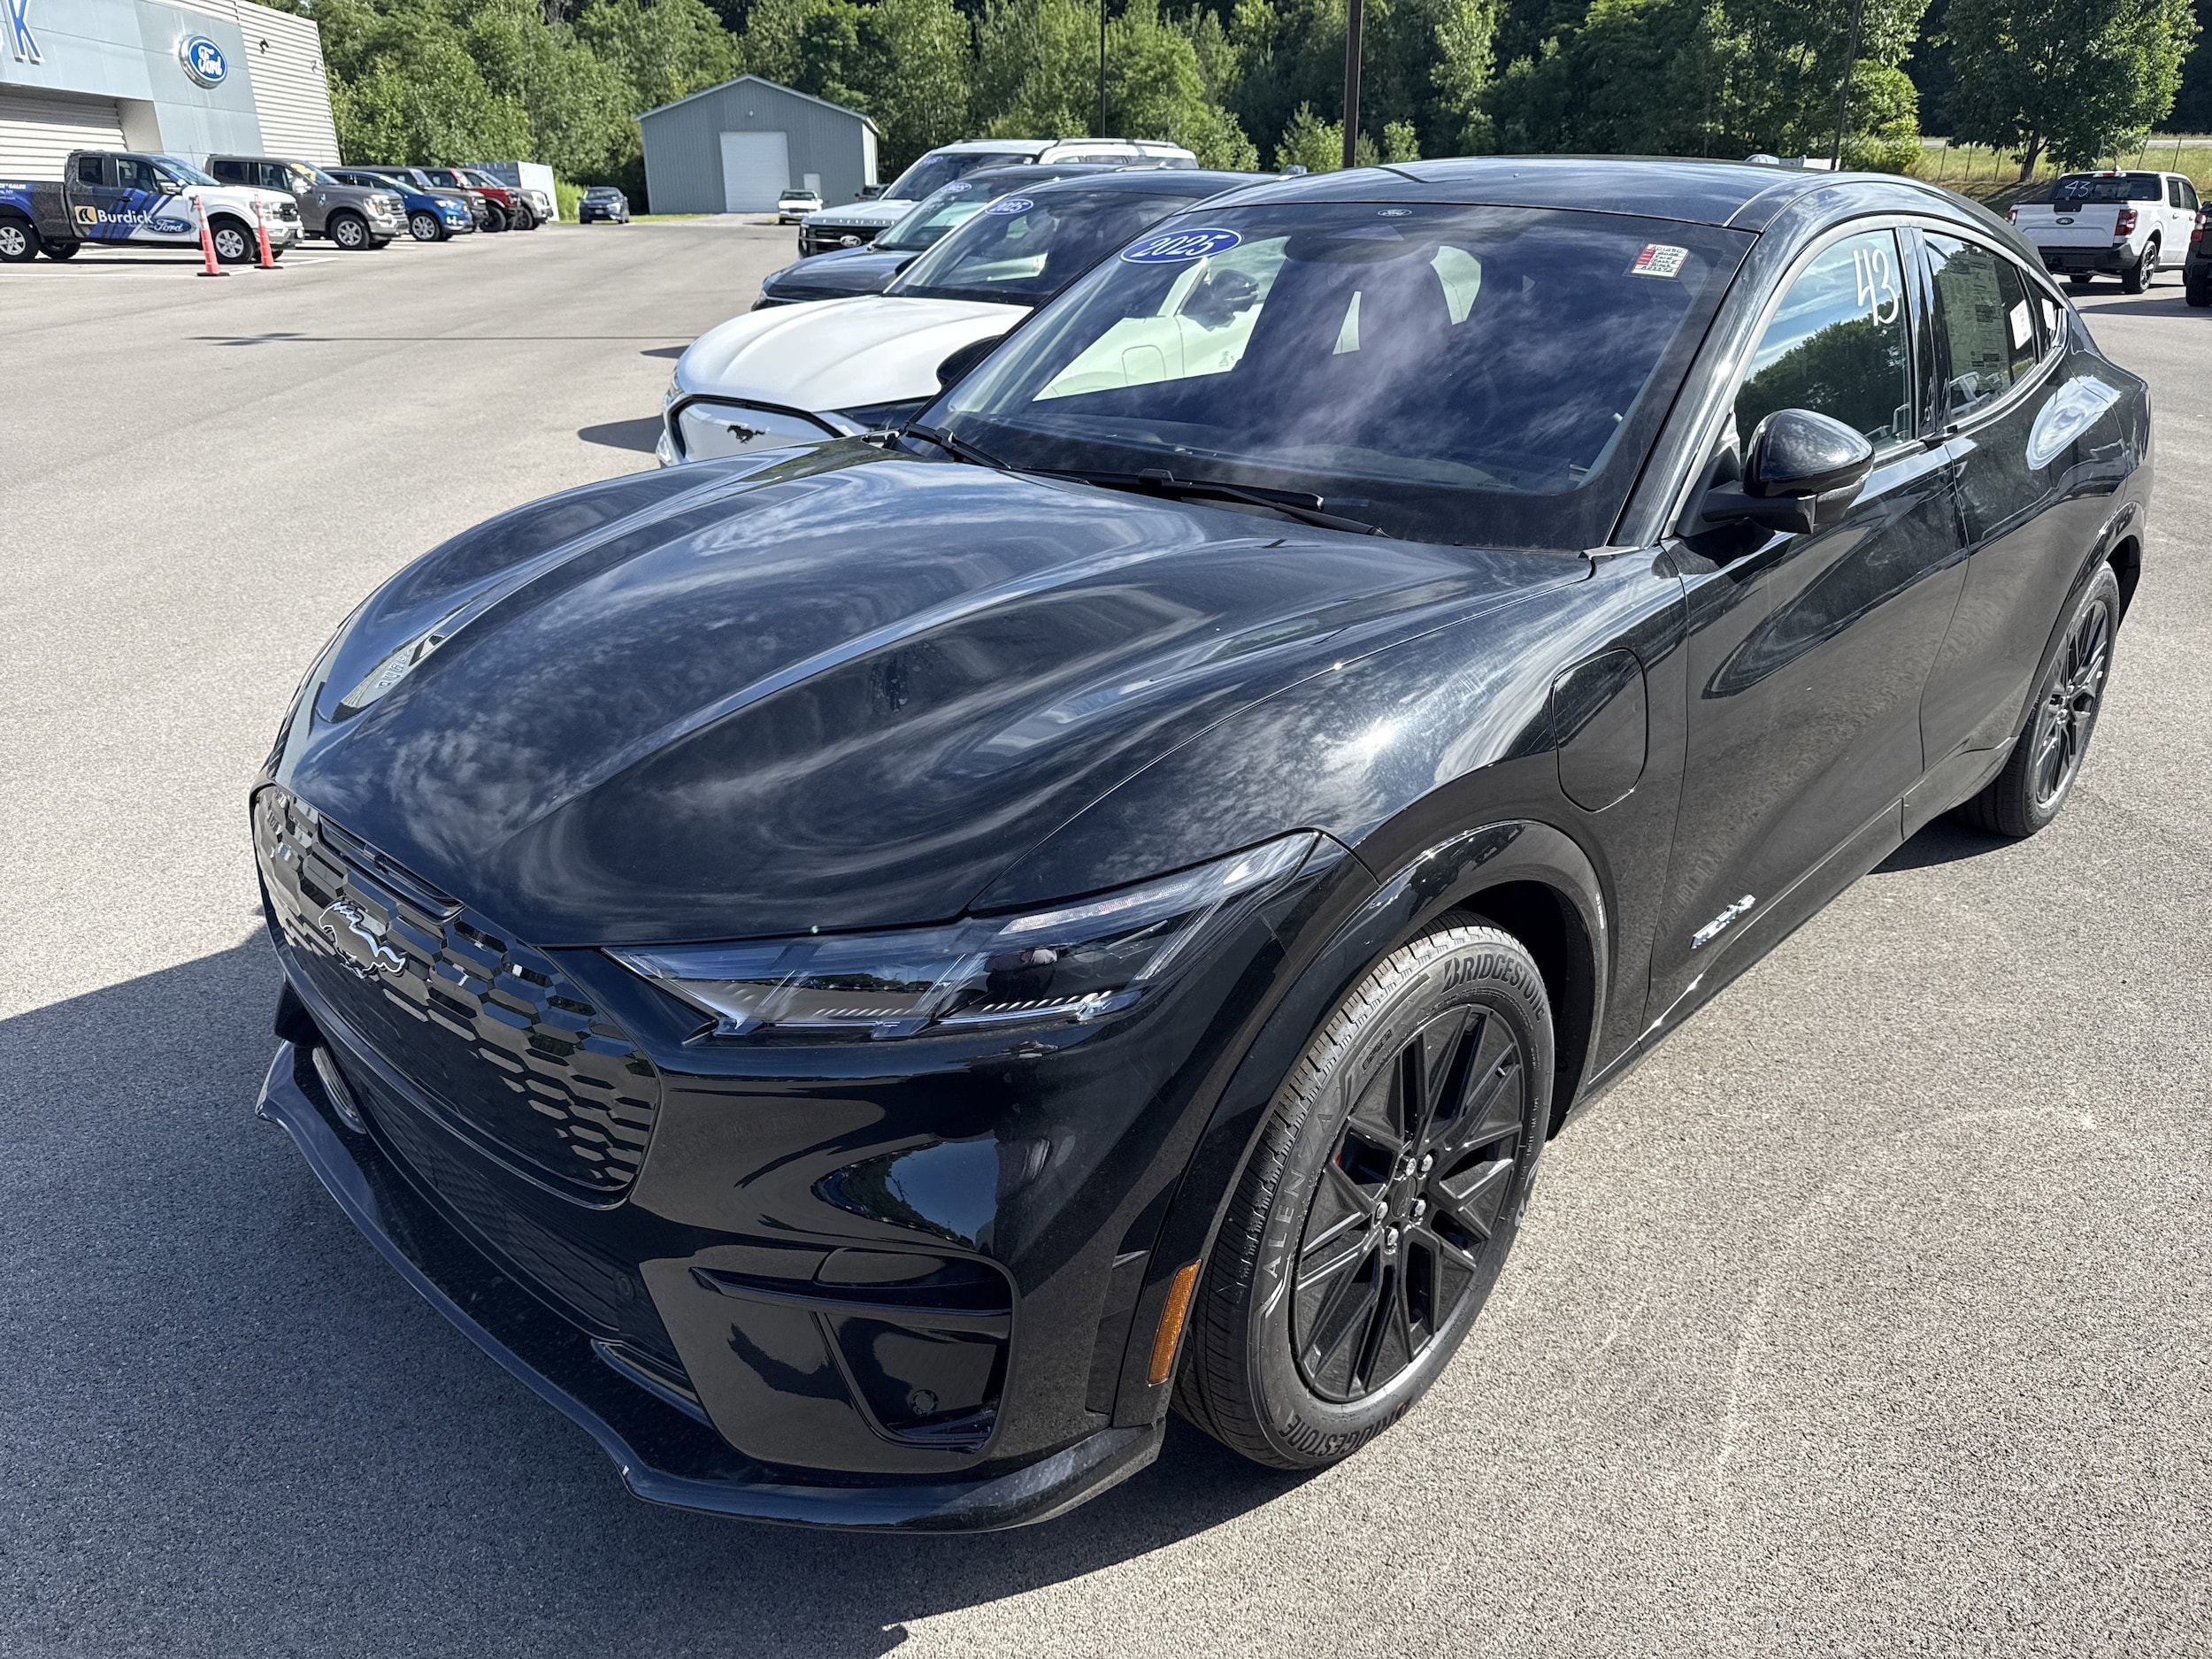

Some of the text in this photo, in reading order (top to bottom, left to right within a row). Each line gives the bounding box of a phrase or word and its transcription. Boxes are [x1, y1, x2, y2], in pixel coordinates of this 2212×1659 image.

[197, 45, 223, 76] Ford
[2064, 180, 2091, 197] 43
[97, 209, 153, 224] Burdick
[154, 219, 184, 232] Ford
[1130, 234, 1231, 257] 2025
[1853, 249, 1899, 326] 43
[1441, 954, 1545, 1021] BRIDGESTONE
